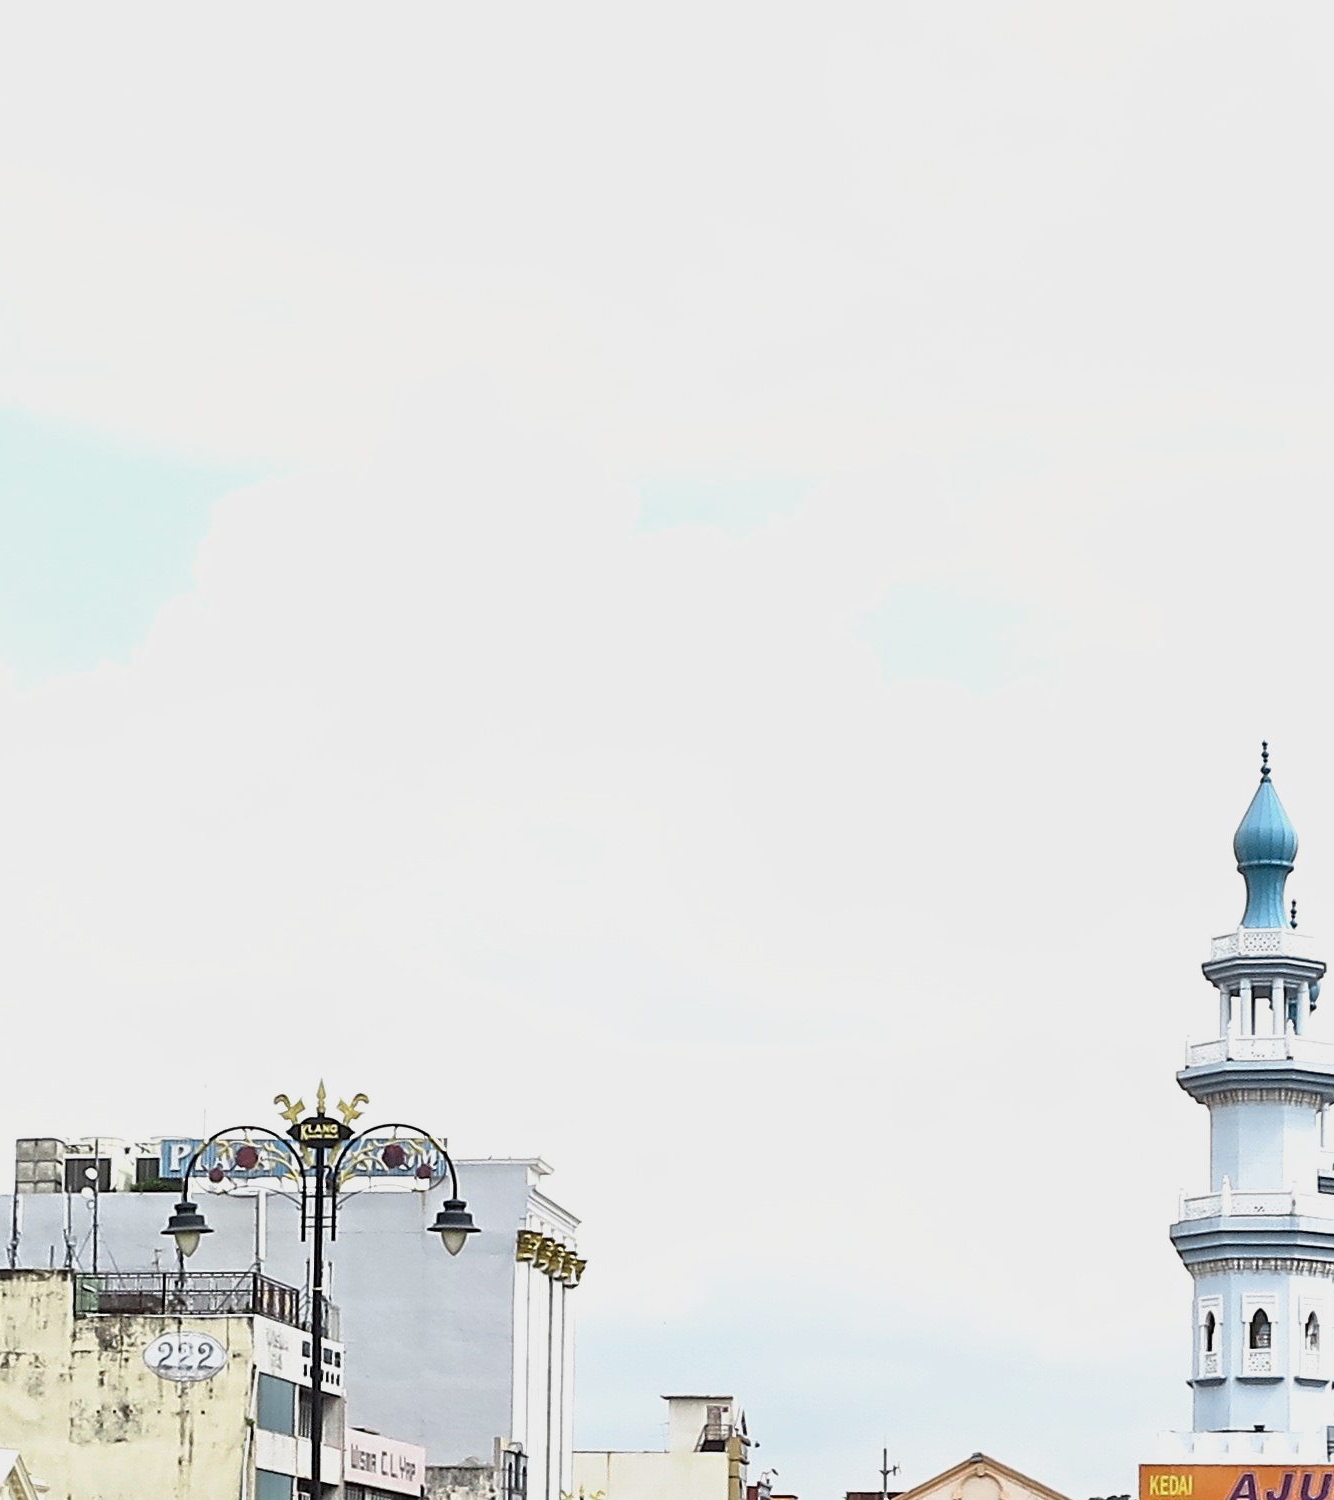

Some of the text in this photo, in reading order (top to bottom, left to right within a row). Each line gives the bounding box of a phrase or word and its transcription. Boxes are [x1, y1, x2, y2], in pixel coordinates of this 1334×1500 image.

[300, 1124, 339, 1141] KLANG
[157, 1341, 215, 1370] 222
[1149, 1475, 1193, 1496] KEDAI
